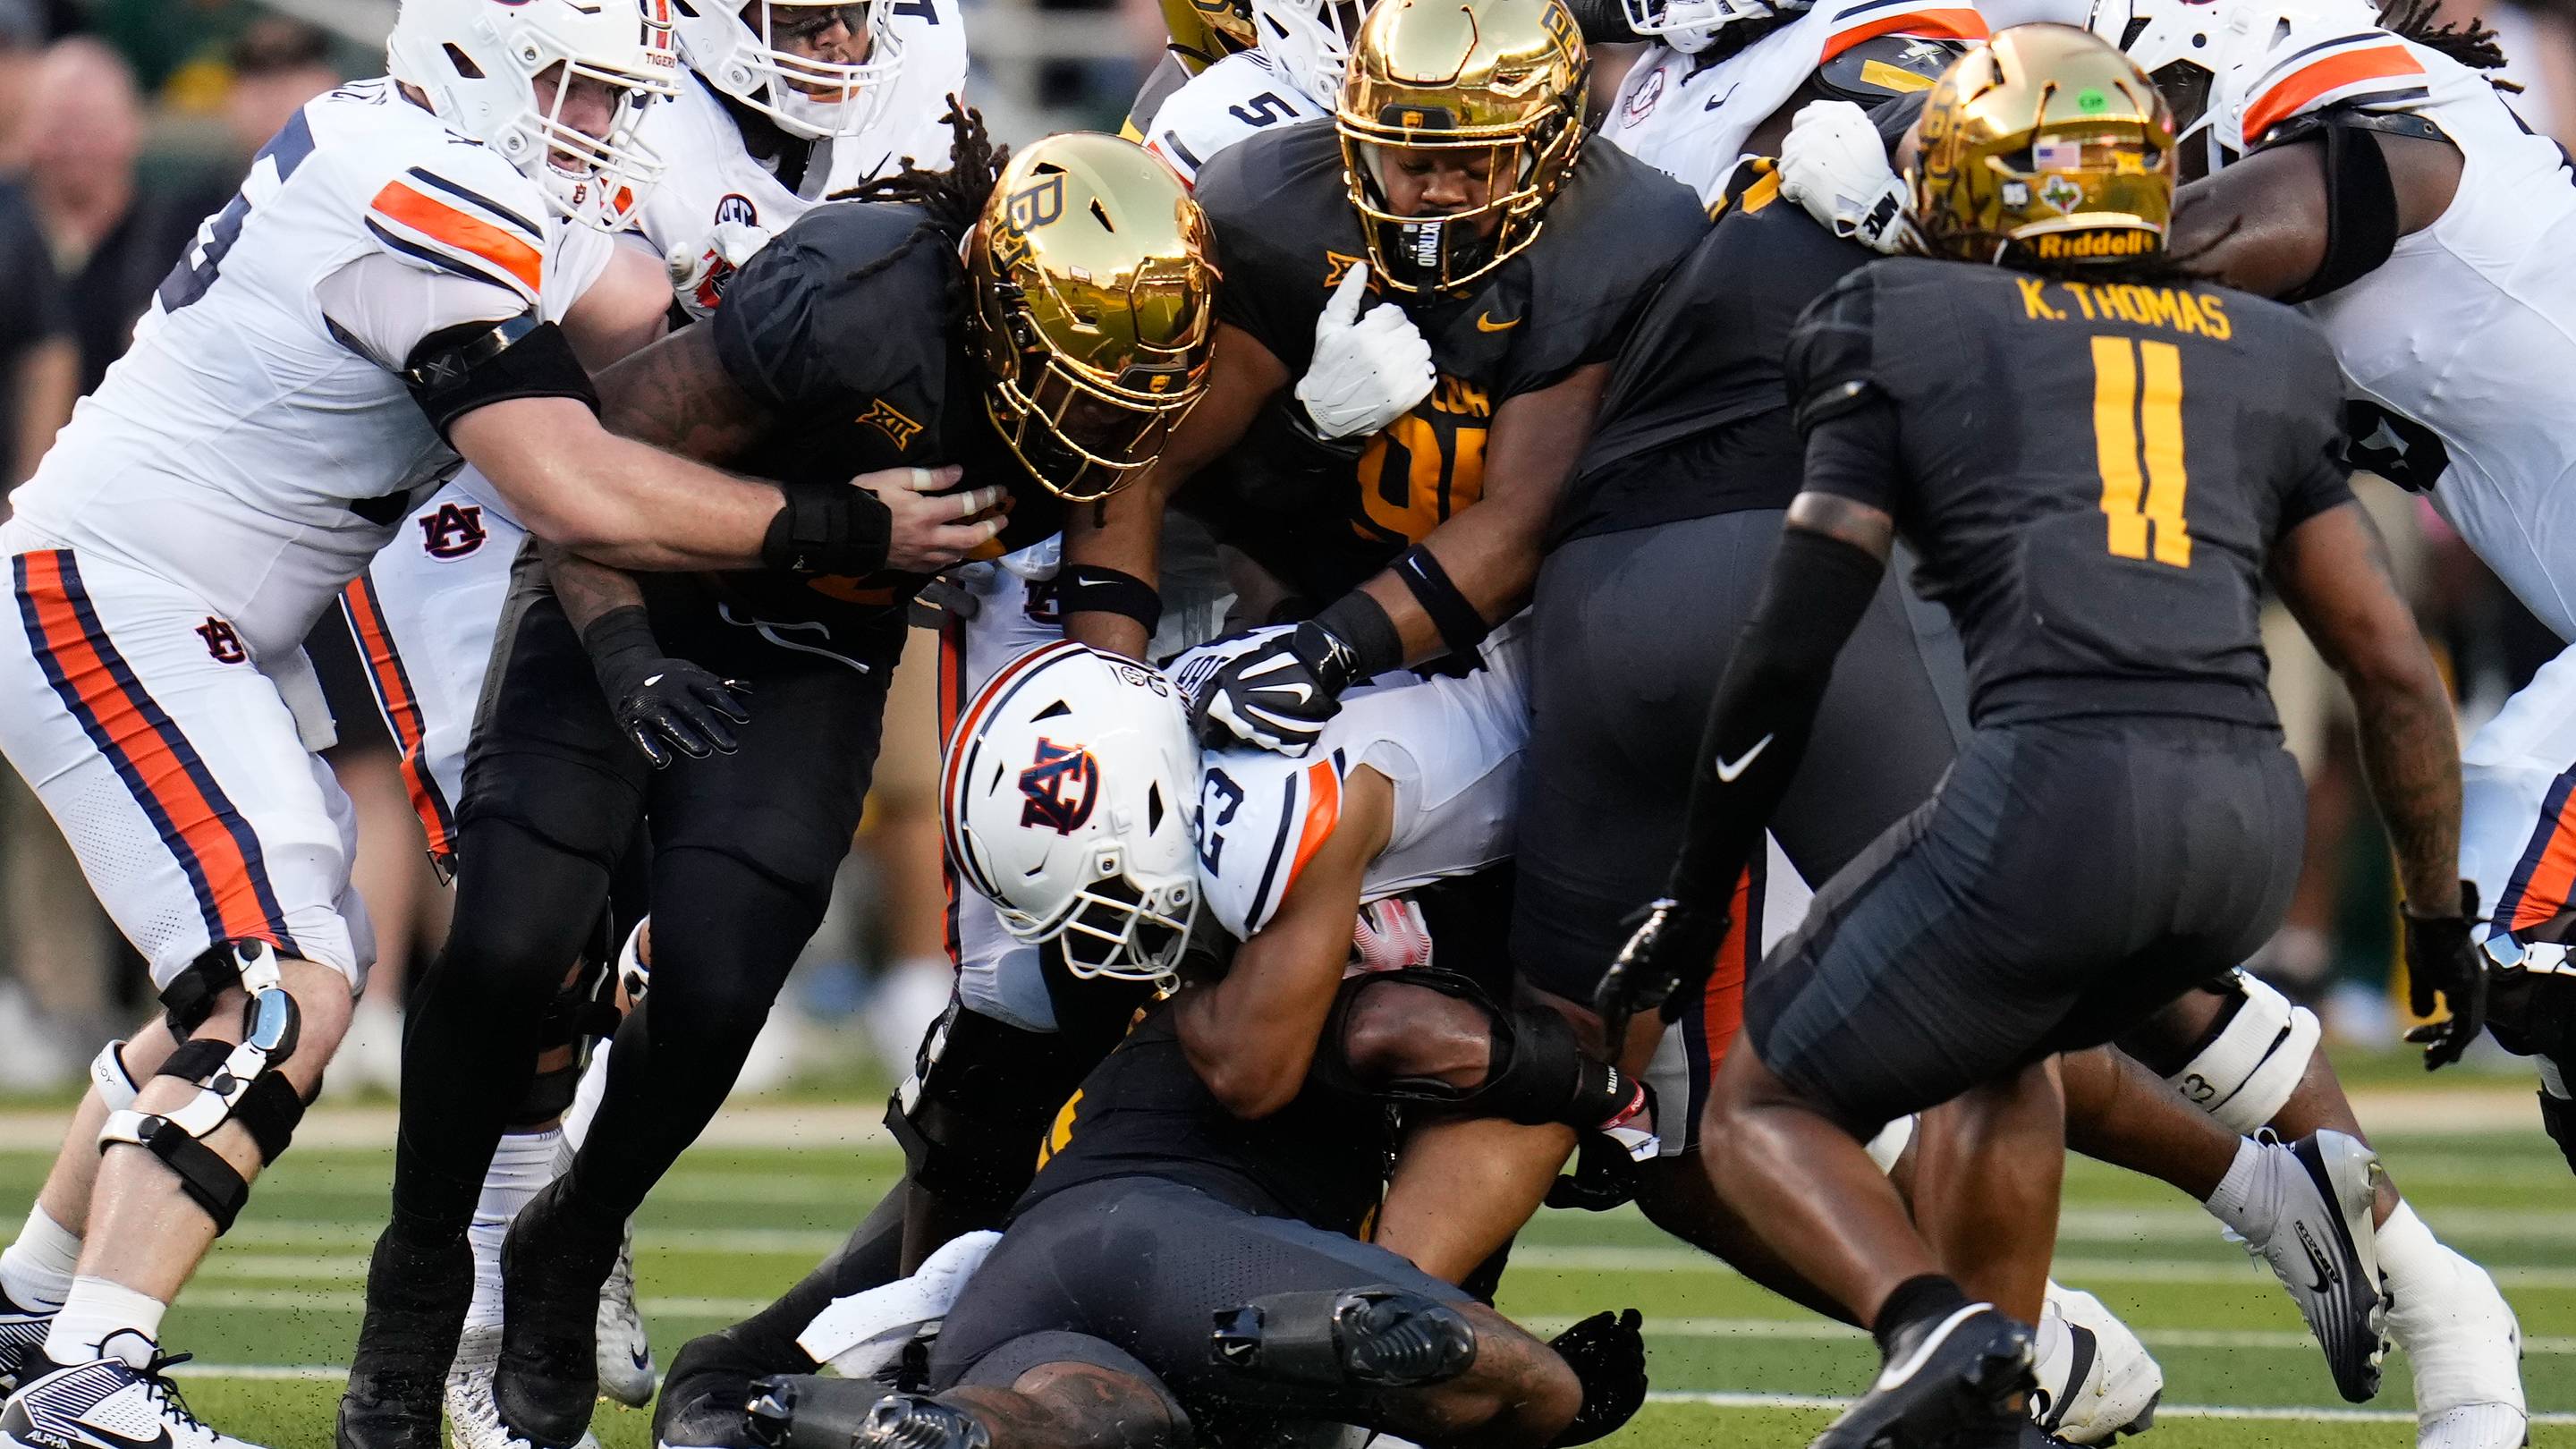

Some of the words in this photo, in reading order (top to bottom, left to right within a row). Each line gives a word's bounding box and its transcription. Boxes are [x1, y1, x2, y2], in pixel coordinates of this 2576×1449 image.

[1228, 91, 1301, 128] 5
[2038, 229, 2144, 259] Riddell
[2016, 267, 2068, 320] K.
[2062, 281, 2233, 341] THOMAS
[2090, 335, 2192, 570] 11
[1195, 767, 1245, 879] 23
